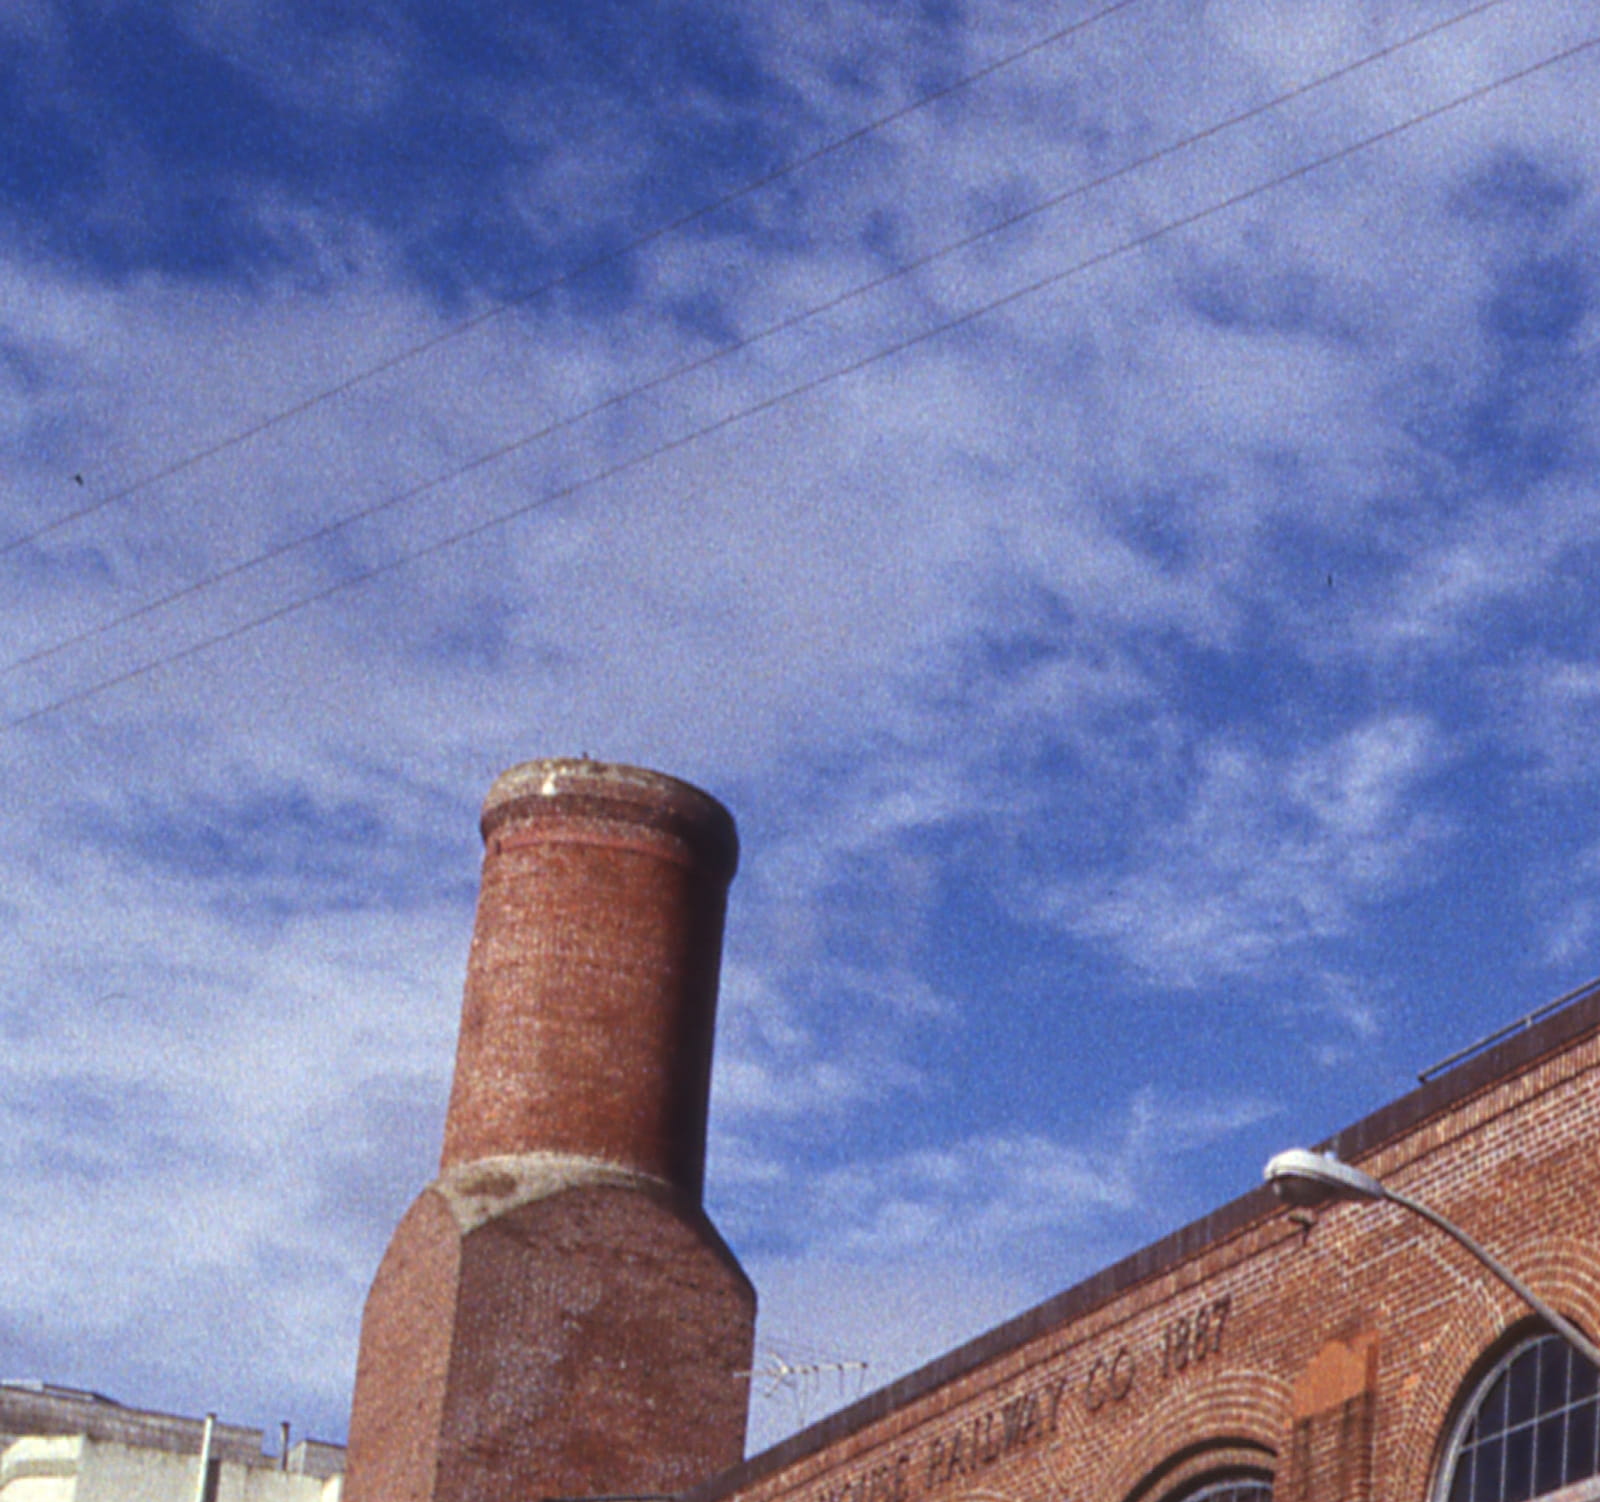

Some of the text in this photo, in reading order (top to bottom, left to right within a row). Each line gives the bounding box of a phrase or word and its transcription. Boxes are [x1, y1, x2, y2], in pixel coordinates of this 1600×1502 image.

[925, 1376, 1067, 1491] RAILWAY
[1085, 1345, 1136, 1413] CO
[1161, 1294, 1232, 1378] 1887
